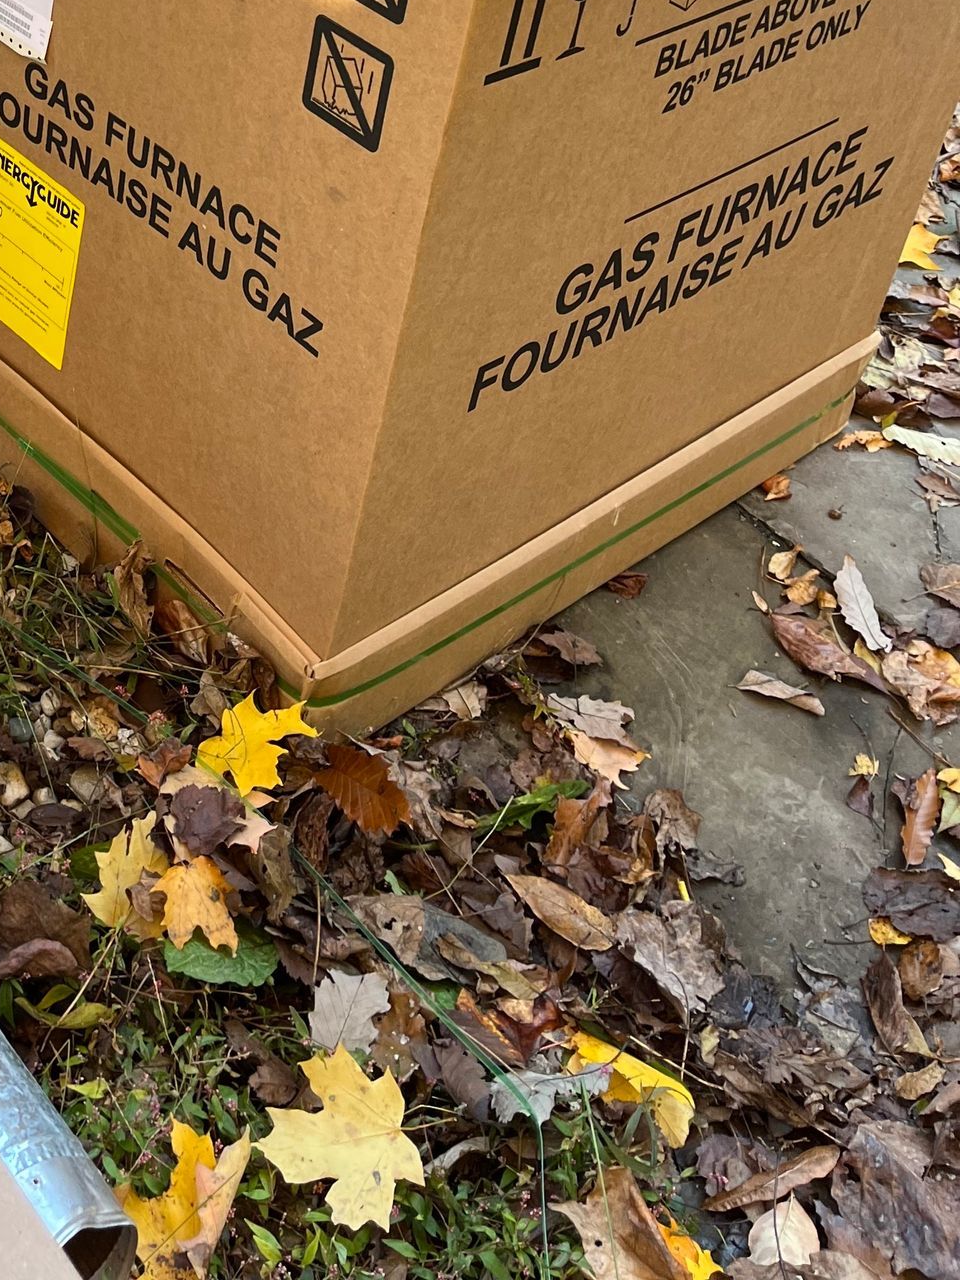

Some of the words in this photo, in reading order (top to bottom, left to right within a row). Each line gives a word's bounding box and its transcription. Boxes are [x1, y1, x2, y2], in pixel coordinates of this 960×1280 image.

[654, 12, 752, 78] BLADE
[713, 29, 803, 93] BLADE
[806, 0, 871, 51] ONLY
[24, 61, 95, 131] GAS
[105, 111, 281, 269] FURNACE
[556, 231, 660, 316] GAS
[667, 125, 868, 264] FURNACE
[177, 221, 231, 281] AU
[242, 268, 324, 359] GAZ
[467, 234, 743, 414] FOURNAISE
[741, 200, 808, 270] AU
[811, 155, 895, 229] GAZ
